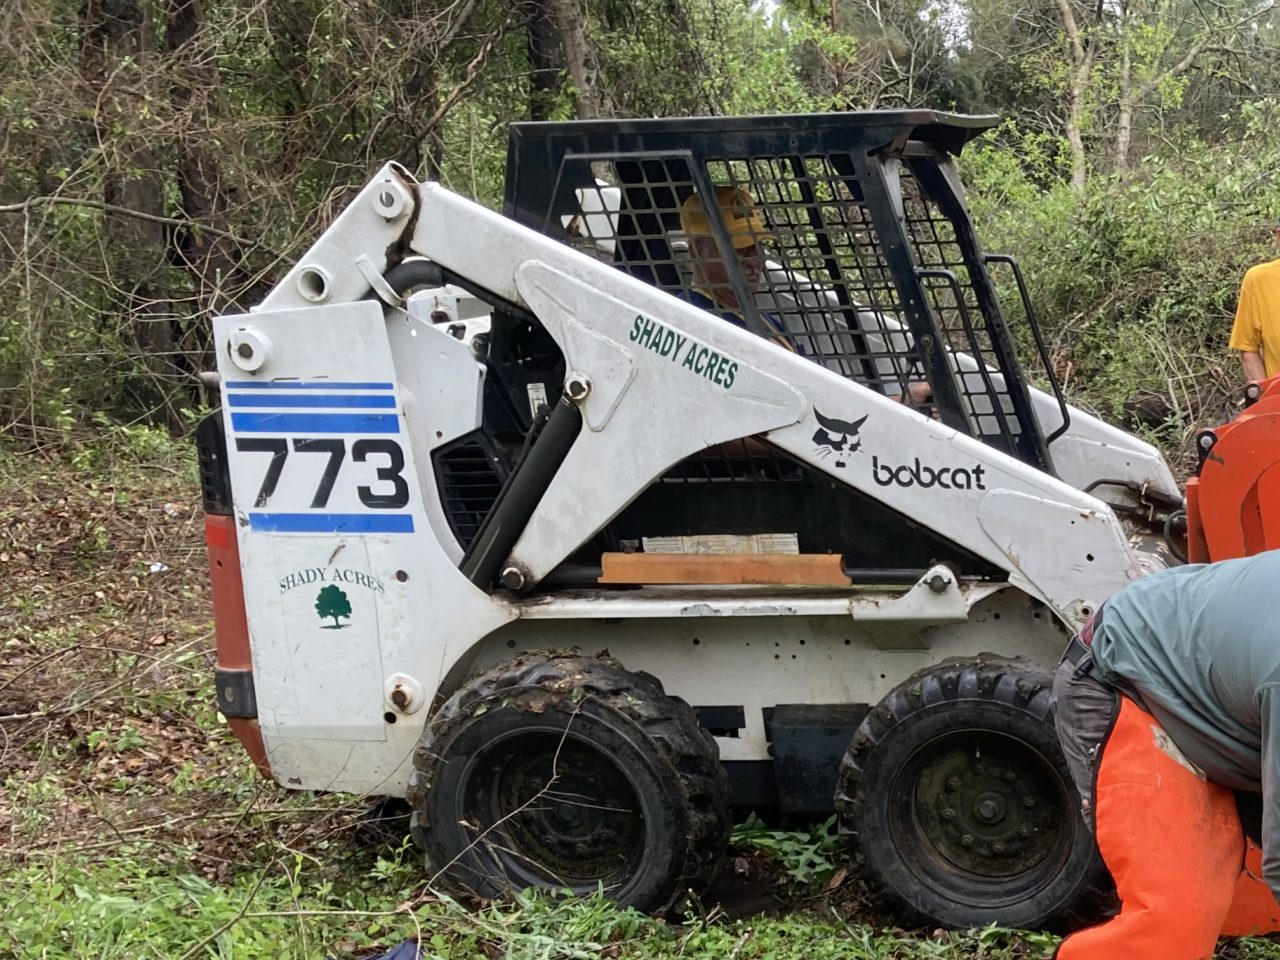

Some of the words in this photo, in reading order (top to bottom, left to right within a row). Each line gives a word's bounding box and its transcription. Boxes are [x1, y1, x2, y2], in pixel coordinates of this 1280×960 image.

[629, 314, 687, 362] SHADY
[682, 342, 738, 389] ACRES
[235, 437, 410, 509] 773
[872, 455, 986, 491] bobcat
[279, 567, 327, 594] SHADY
[332, 567, 386, 595] ACRES
